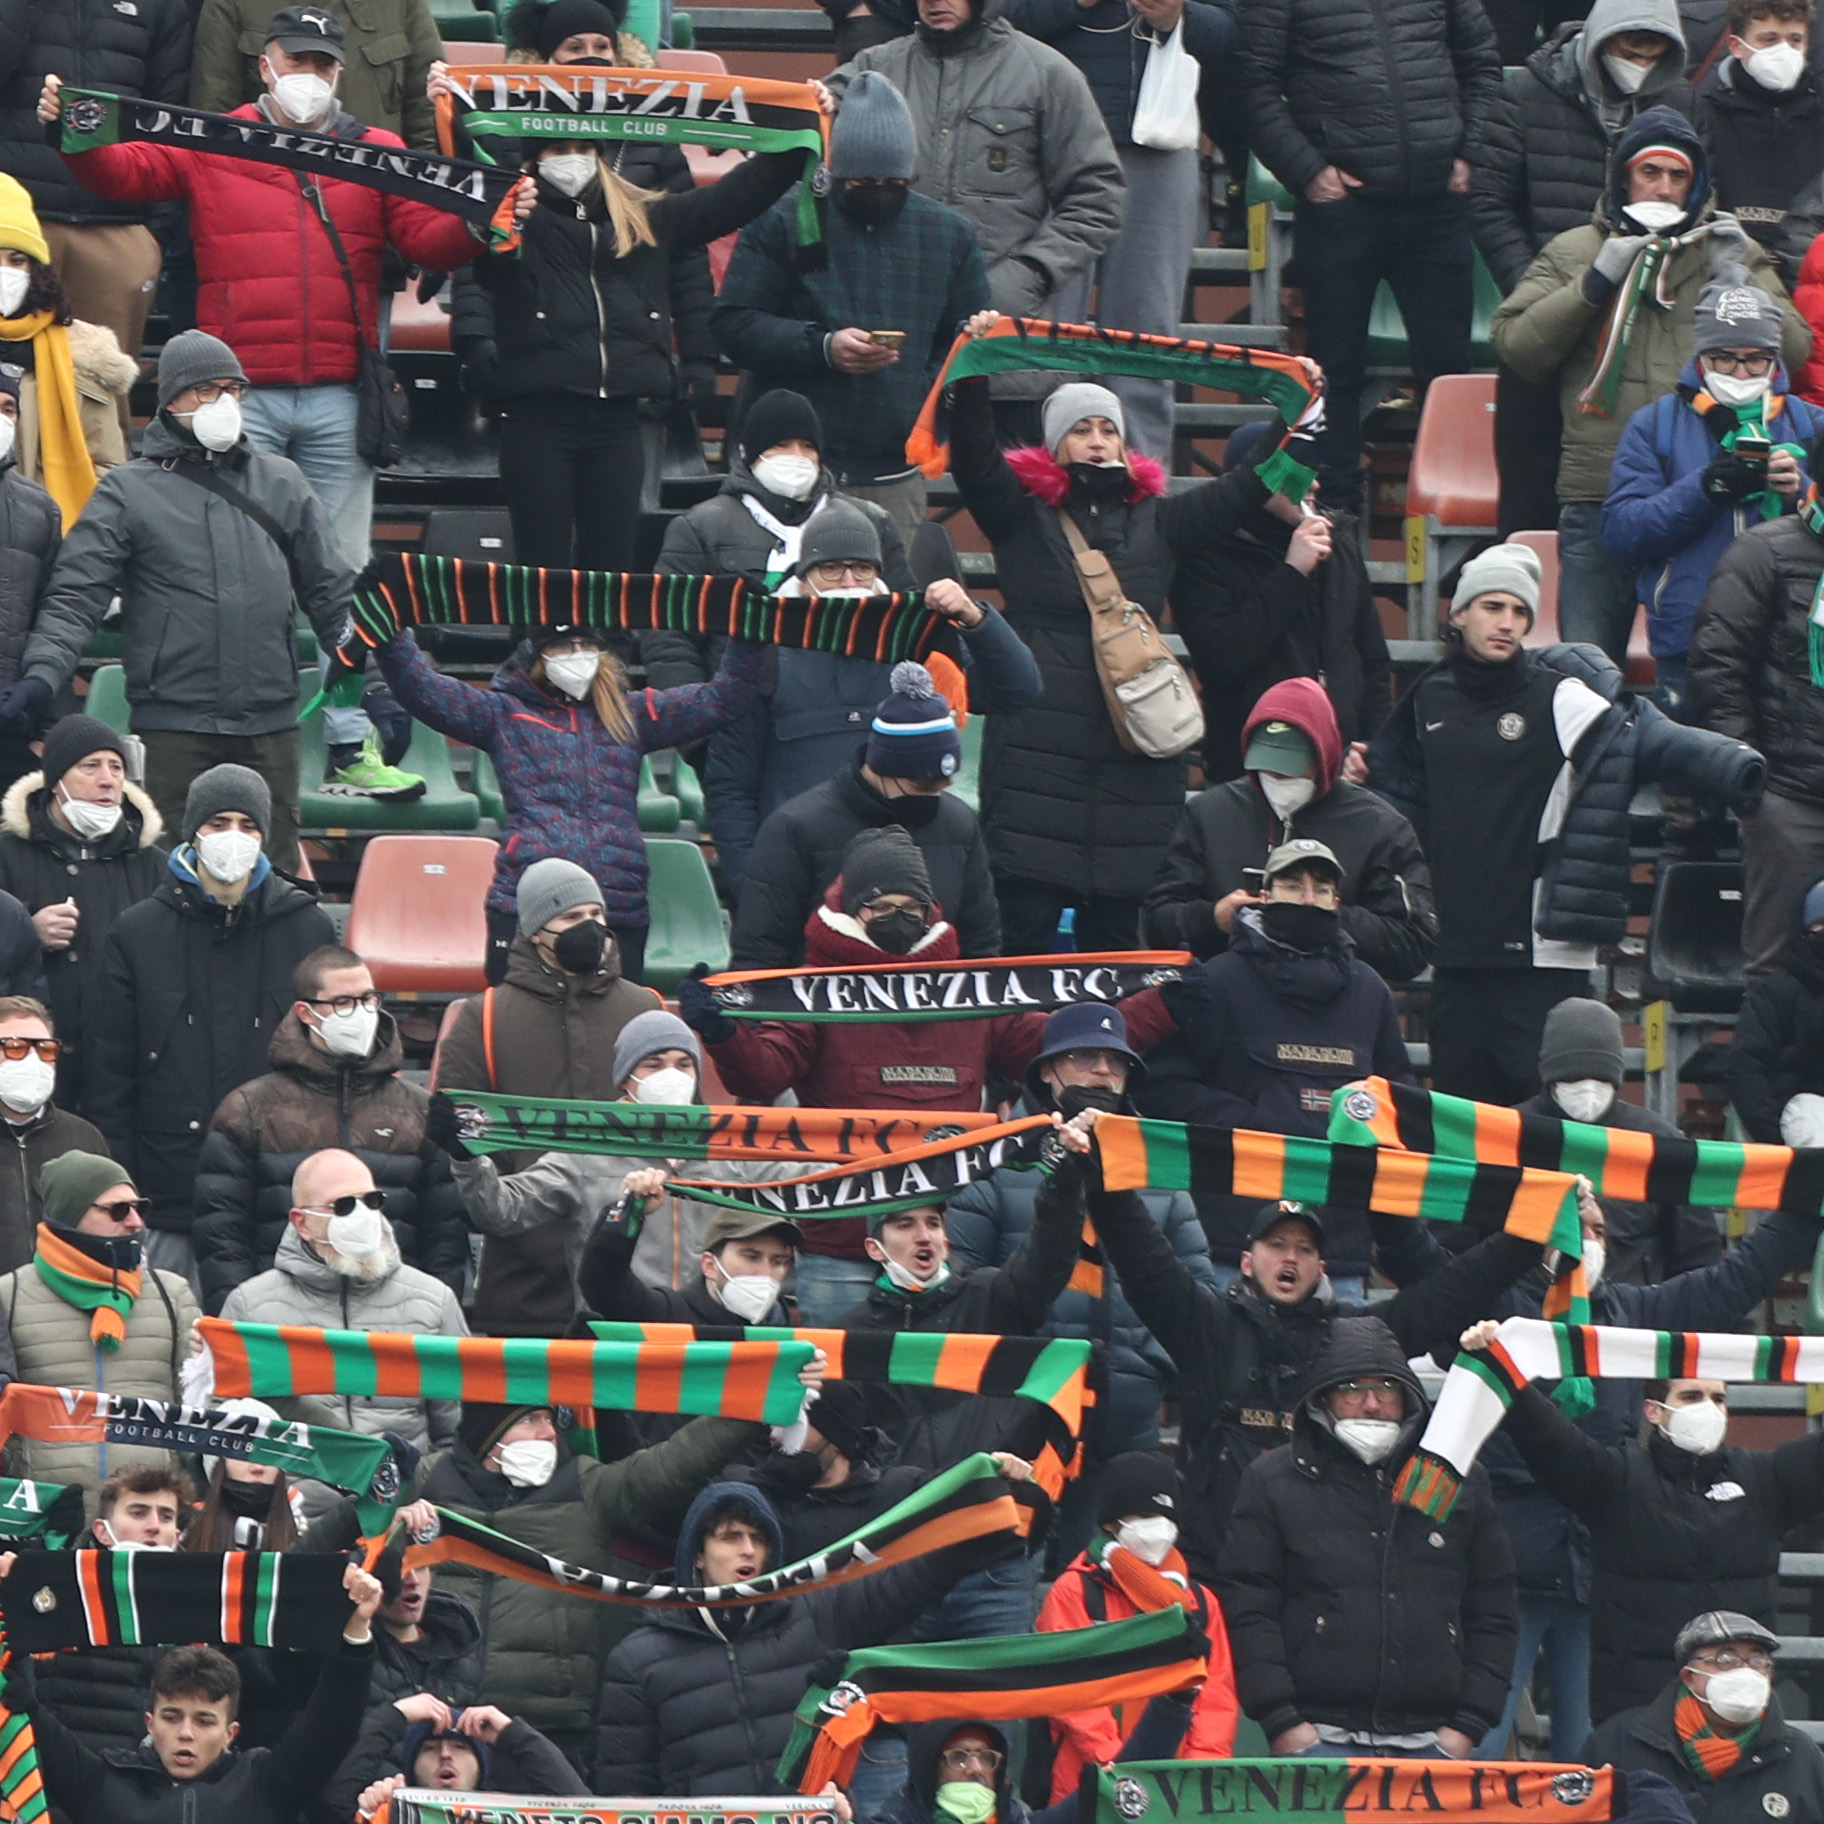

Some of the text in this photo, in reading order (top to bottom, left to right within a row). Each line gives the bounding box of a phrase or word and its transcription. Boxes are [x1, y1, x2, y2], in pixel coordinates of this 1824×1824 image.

[450, 74, 755, 124] VENEZIA
[520, 117, 668, 135] FOOTBALL CLUB
[135, 110, 488, 203] VENEZIA FC
[792, 965, 1125, 1012] VENEZIA FC
[499, 1103, 804, 1155] VENEZIA
[55, 1386, 315, 1449] VENEZIA
[102, 1423, 254, 1453] FOOTBALL CLUB
[1149, 1764, 1545, 1818] VENEZIA FC
